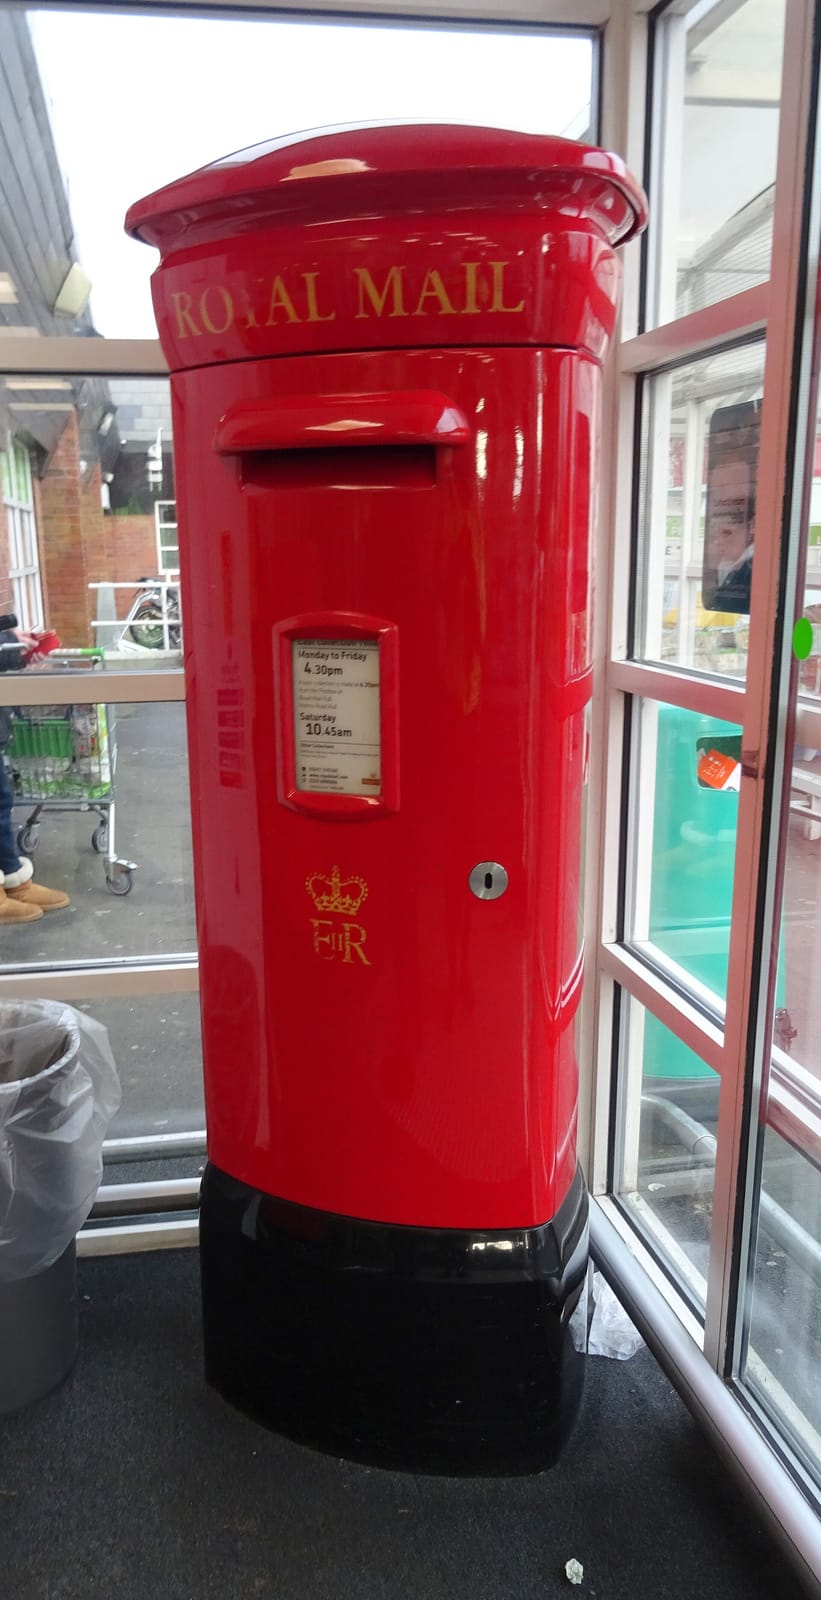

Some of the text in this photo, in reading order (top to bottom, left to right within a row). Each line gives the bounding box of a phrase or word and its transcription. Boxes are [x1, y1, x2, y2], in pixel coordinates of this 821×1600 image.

[353, 261, 526, 318] MAIL
[298, 650, 368, 662] Monday to Friday
[304, 661, 343, 677] 4.30pm
[299, 712, 337, 723] Saturday
[305, 722, 353, 737] 10.45am
